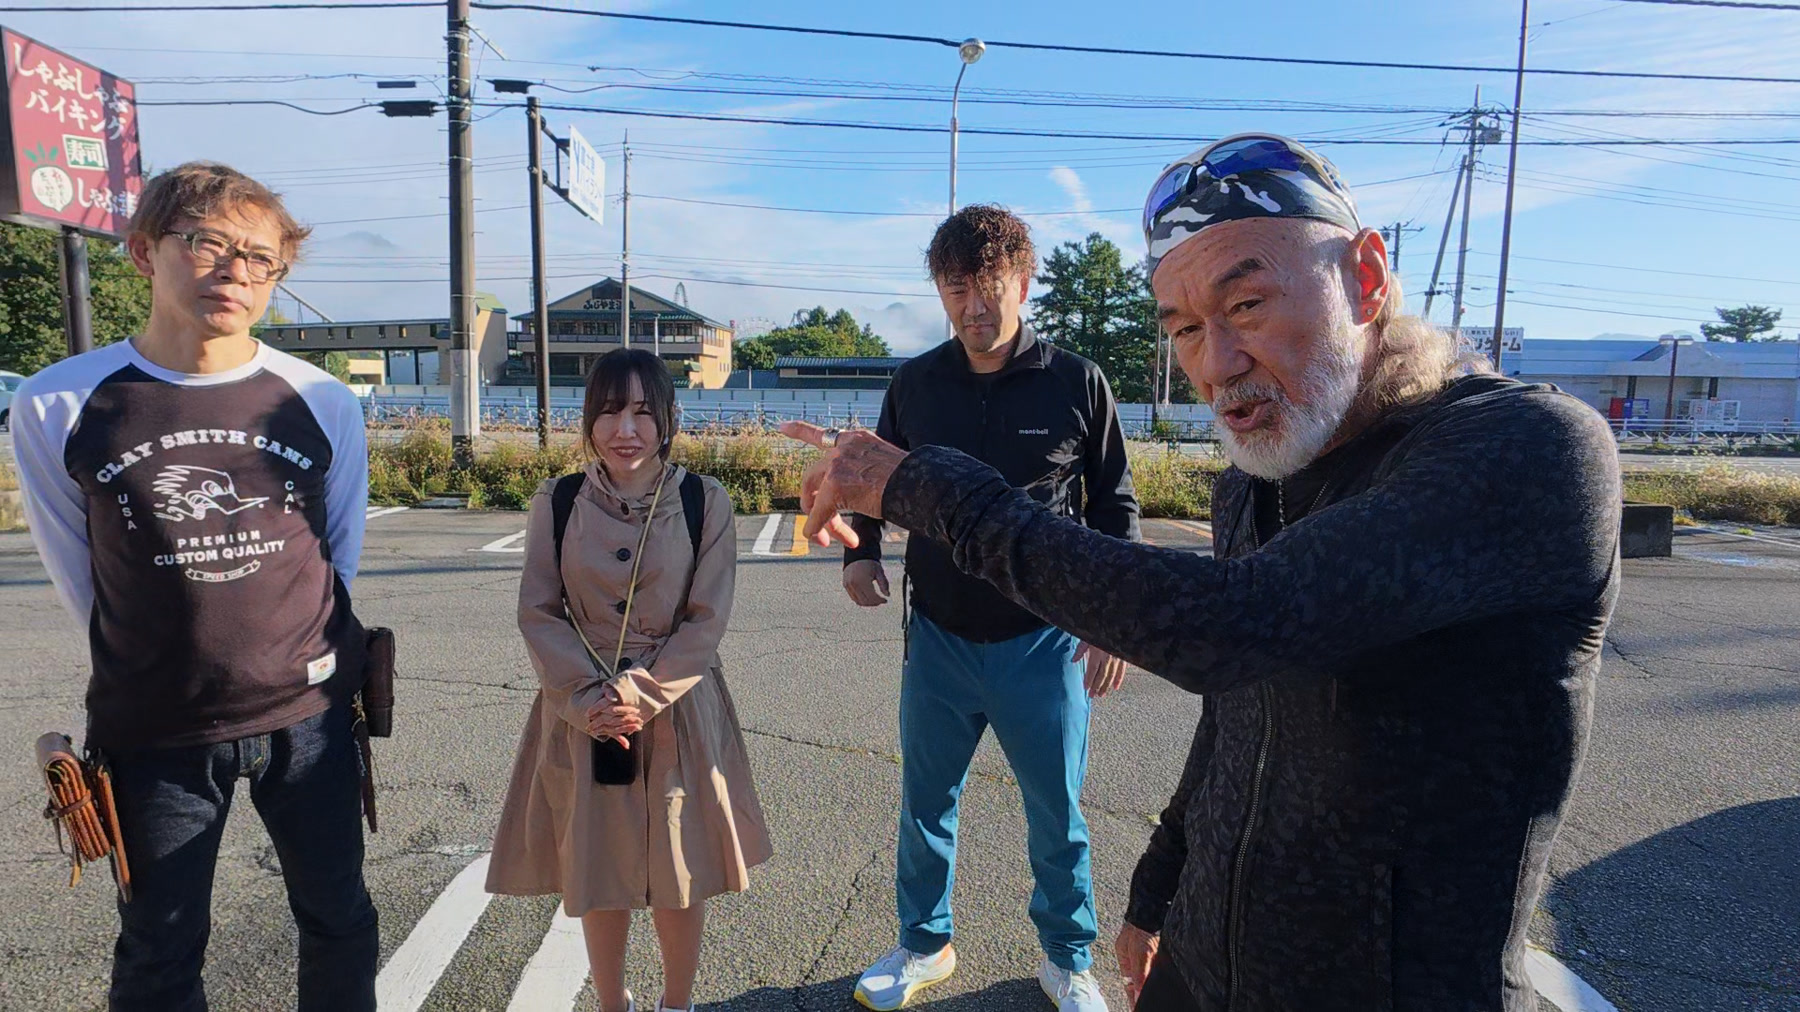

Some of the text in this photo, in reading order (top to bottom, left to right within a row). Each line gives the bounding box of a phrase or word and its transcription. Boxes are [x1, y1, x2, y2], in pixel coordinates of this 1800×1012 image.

[13, 42, 129, 114] しゃぶしゃぶ
[25, 88, 127, 141] バイキング
[66, 138, 104, 167] 寿司
[96, 429, 313, 484] CLAY SMITH CAMS
[117, 493, 138, 531] USA
[153, 539, 285, 566] CUSTOM QUALITY
[177, 529, 261, 549] PREMIUM
